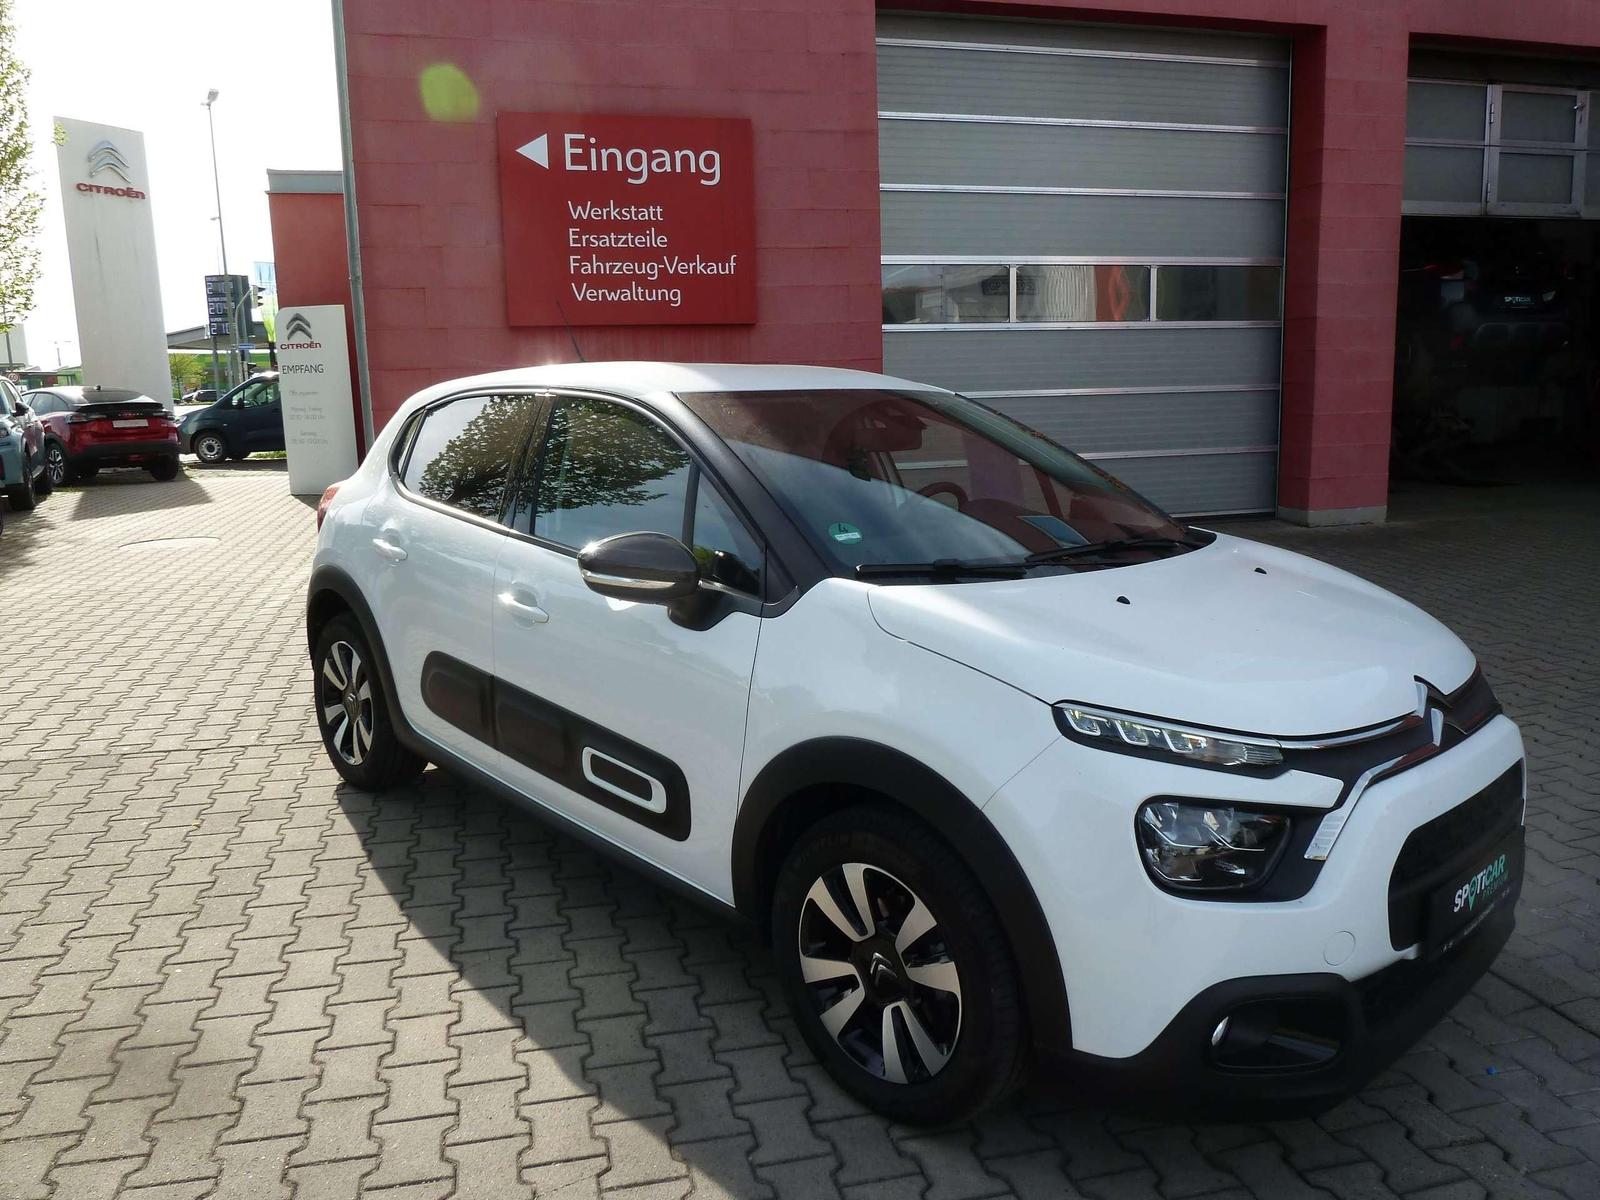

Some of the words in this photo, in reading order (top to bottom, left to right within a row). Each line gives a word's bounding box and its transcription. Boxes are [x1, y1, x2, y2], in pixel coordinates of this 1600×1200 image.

[564, 133, 721, 186] Eingang
[567, 199, 664, 221] Werkstatt
[568, 227, 668, 248] Ersatzteile
[569, 253, 737, 280] Fahrzeug-Verkauf
[571, 281, 682, 307] Verwaltung
[280, 341, 322, 350] CITROËN
[282, 363, 325, 374] EMPFANG
